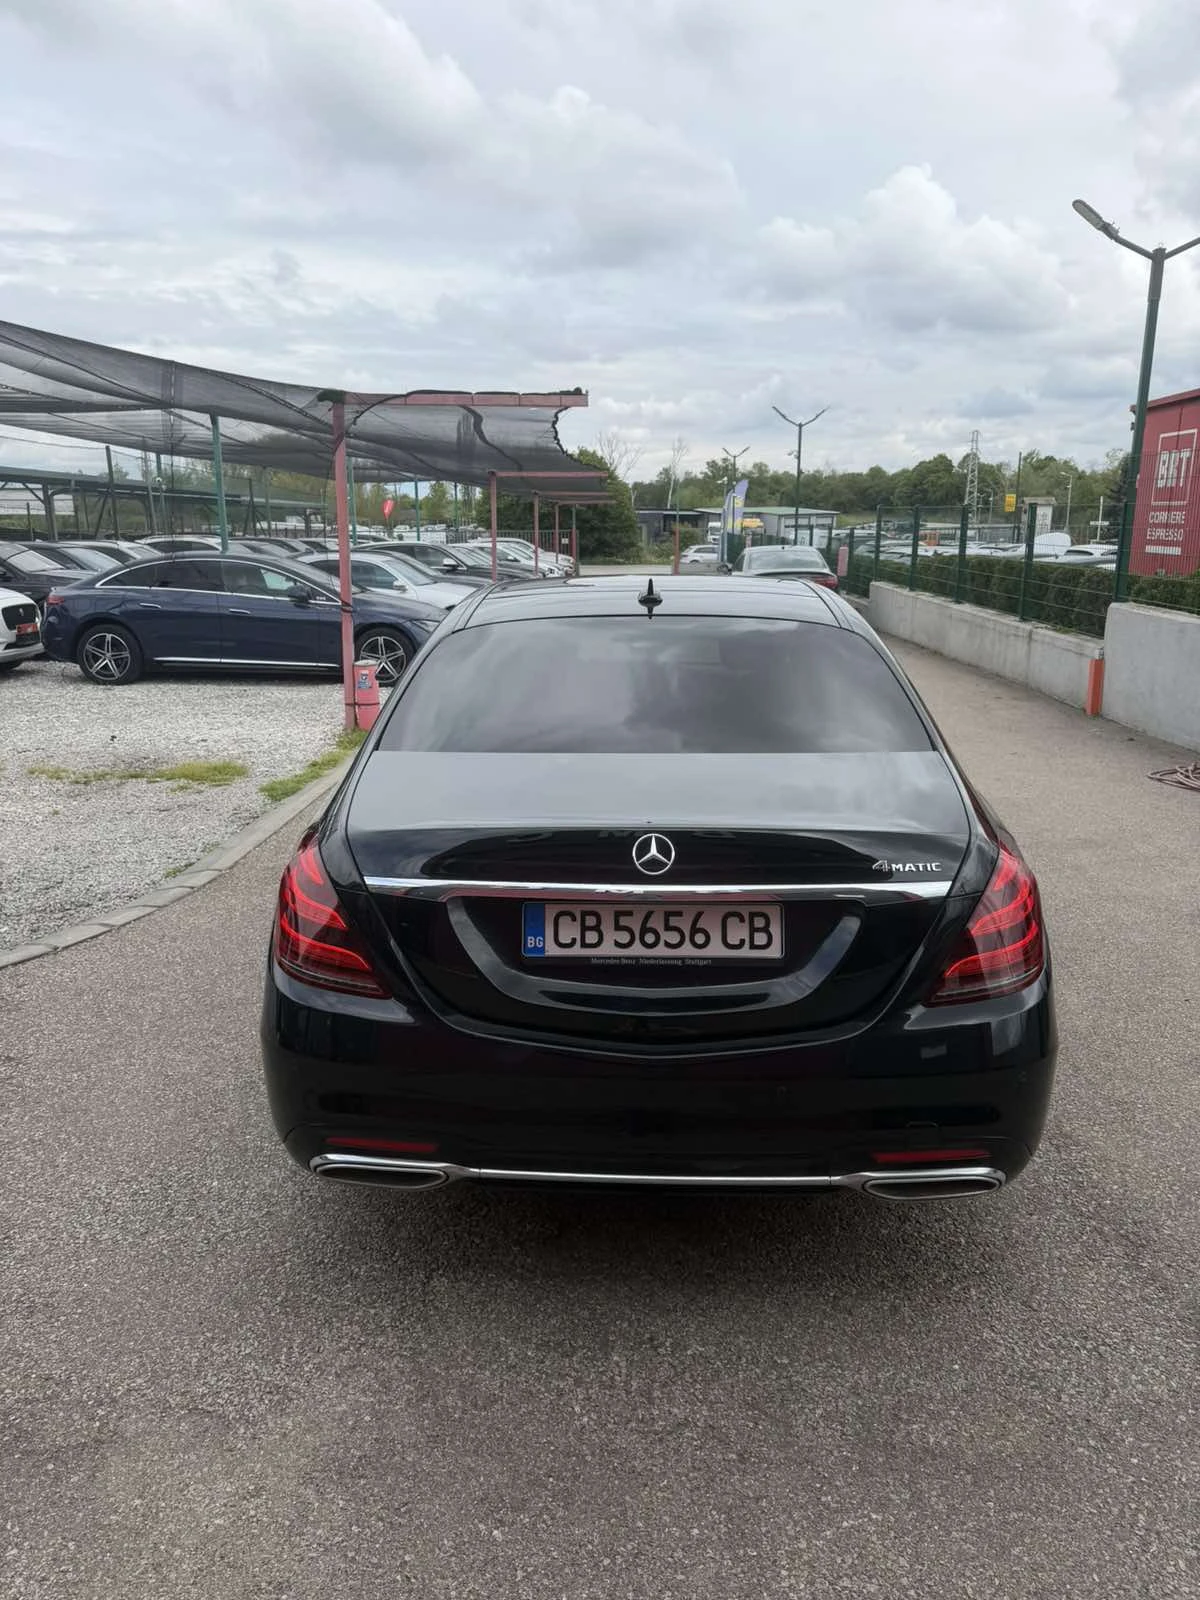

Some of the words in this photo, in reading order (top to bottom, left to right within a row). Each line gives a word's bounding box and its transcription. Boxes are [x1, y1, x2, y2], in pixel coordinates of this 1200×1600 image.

[1146, 528, 1184, 541] ESPRESSO
[872, 859, 942, 872] 4MATIC
[553, 910, 604, 949] CB
[613, 910, 711, 949] 5656
[721, 911, 773, 950] CB
[527, 936, 544, 948] BG
